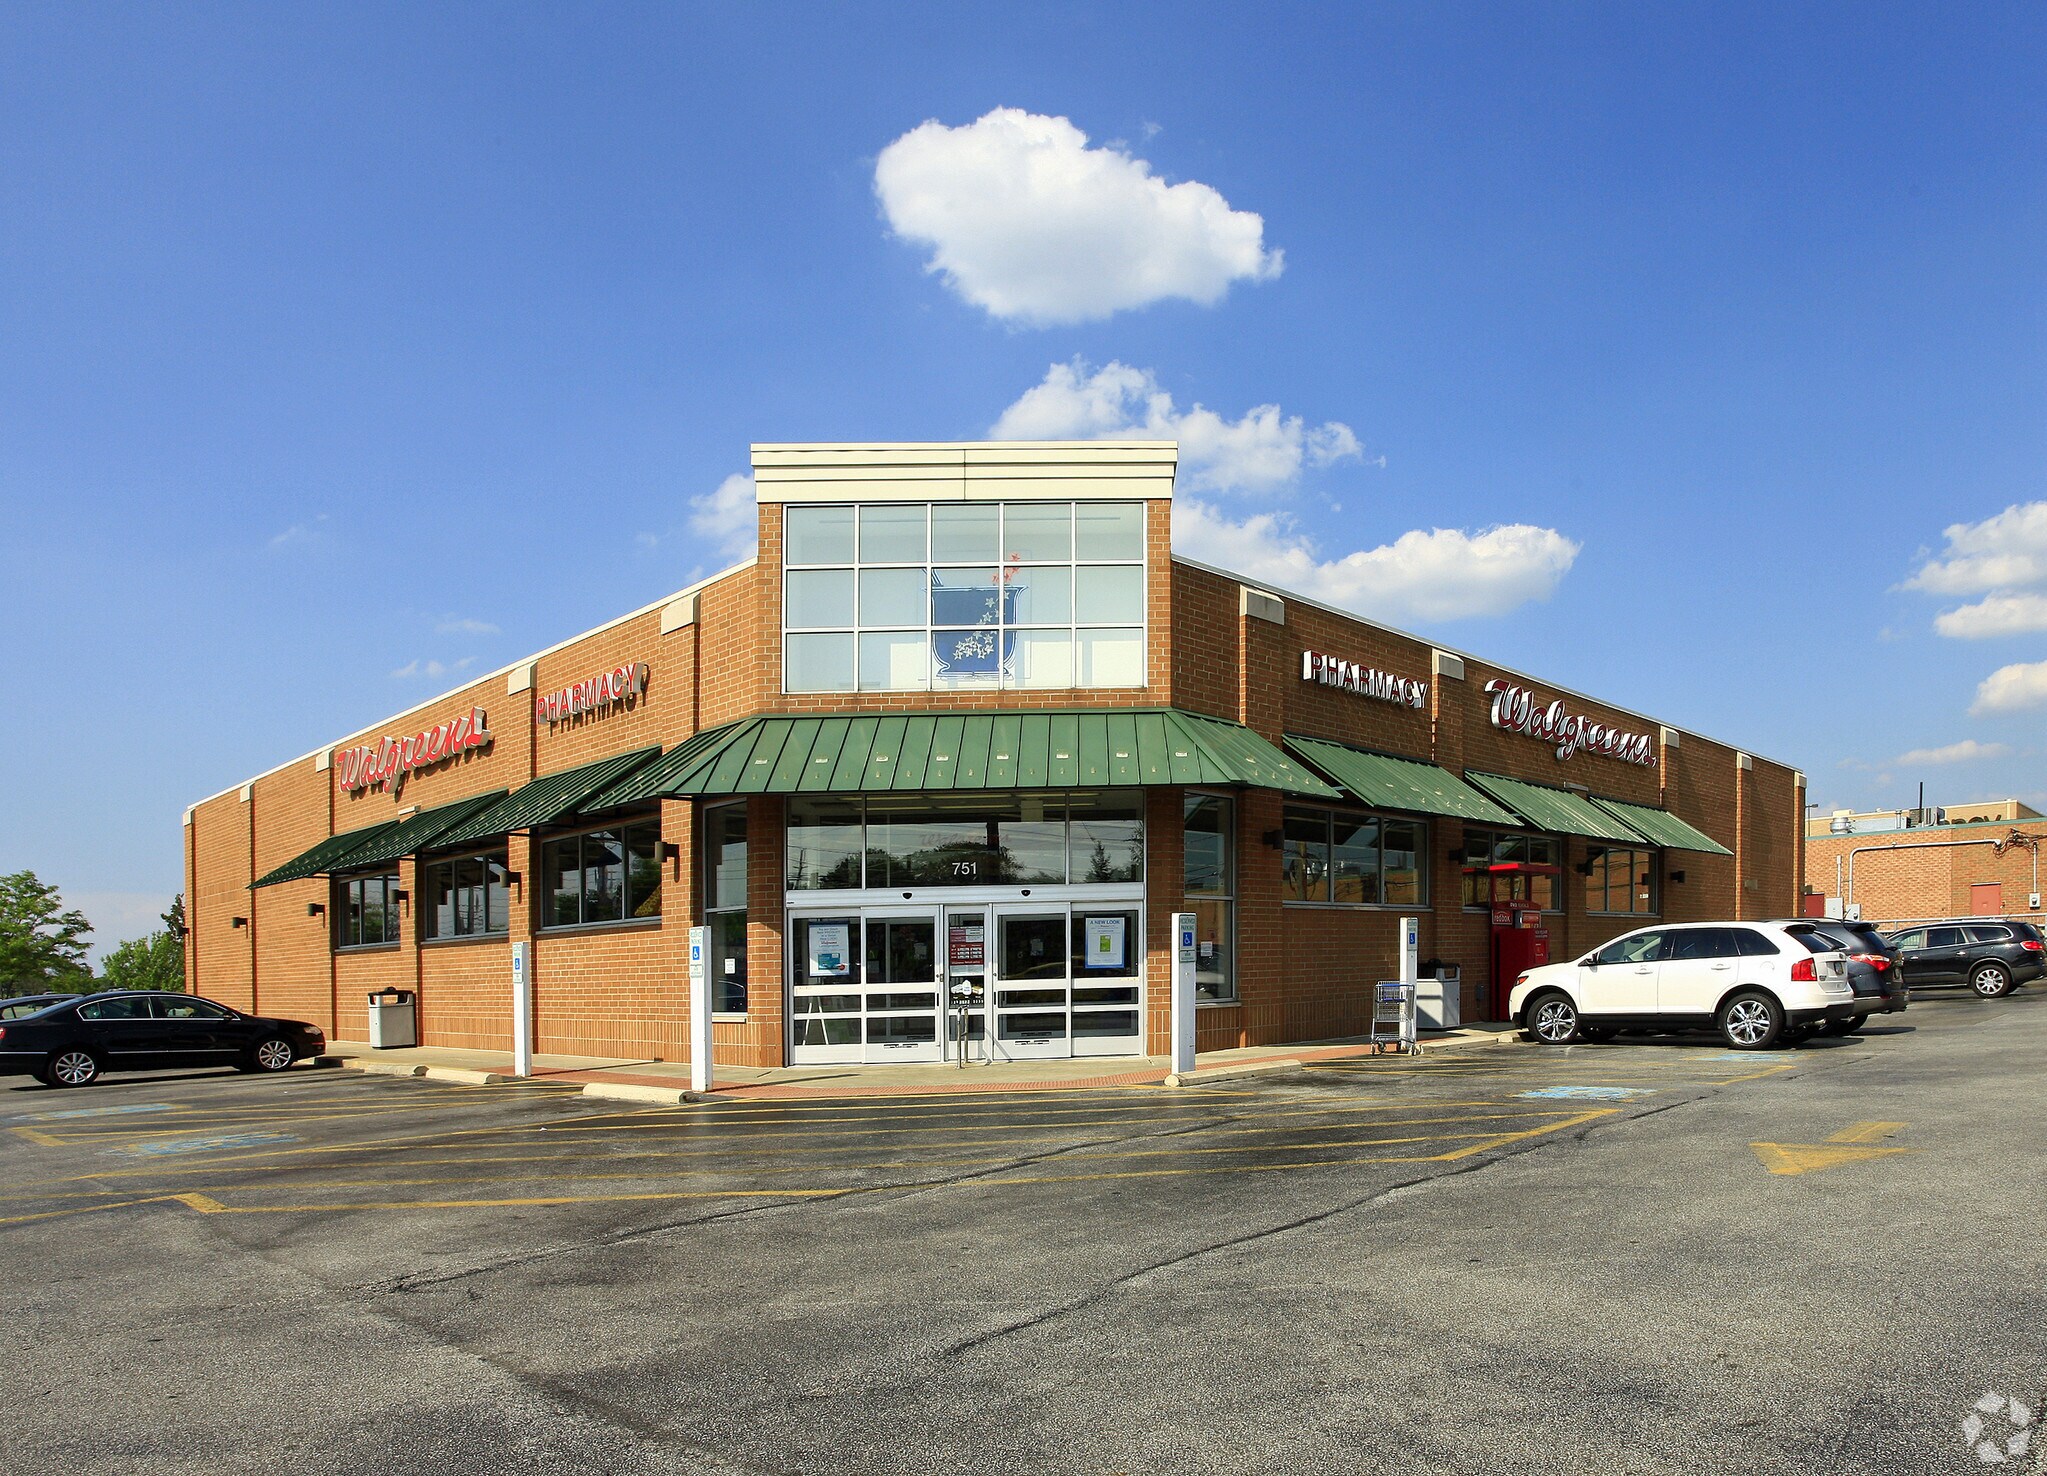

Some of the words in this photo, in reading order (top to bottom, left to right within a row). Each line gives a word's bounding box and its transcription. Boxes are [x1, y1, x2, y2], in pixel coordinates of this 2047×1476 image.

[536, 661, 646, 725] PHARMACY
[1302, 649, 1429, 709] PHARMACY
[335, 706, 492, 795] Walgreens
[1484, 677, 1658, 768] Walgreens
[951, 861, 977, 876] 751
